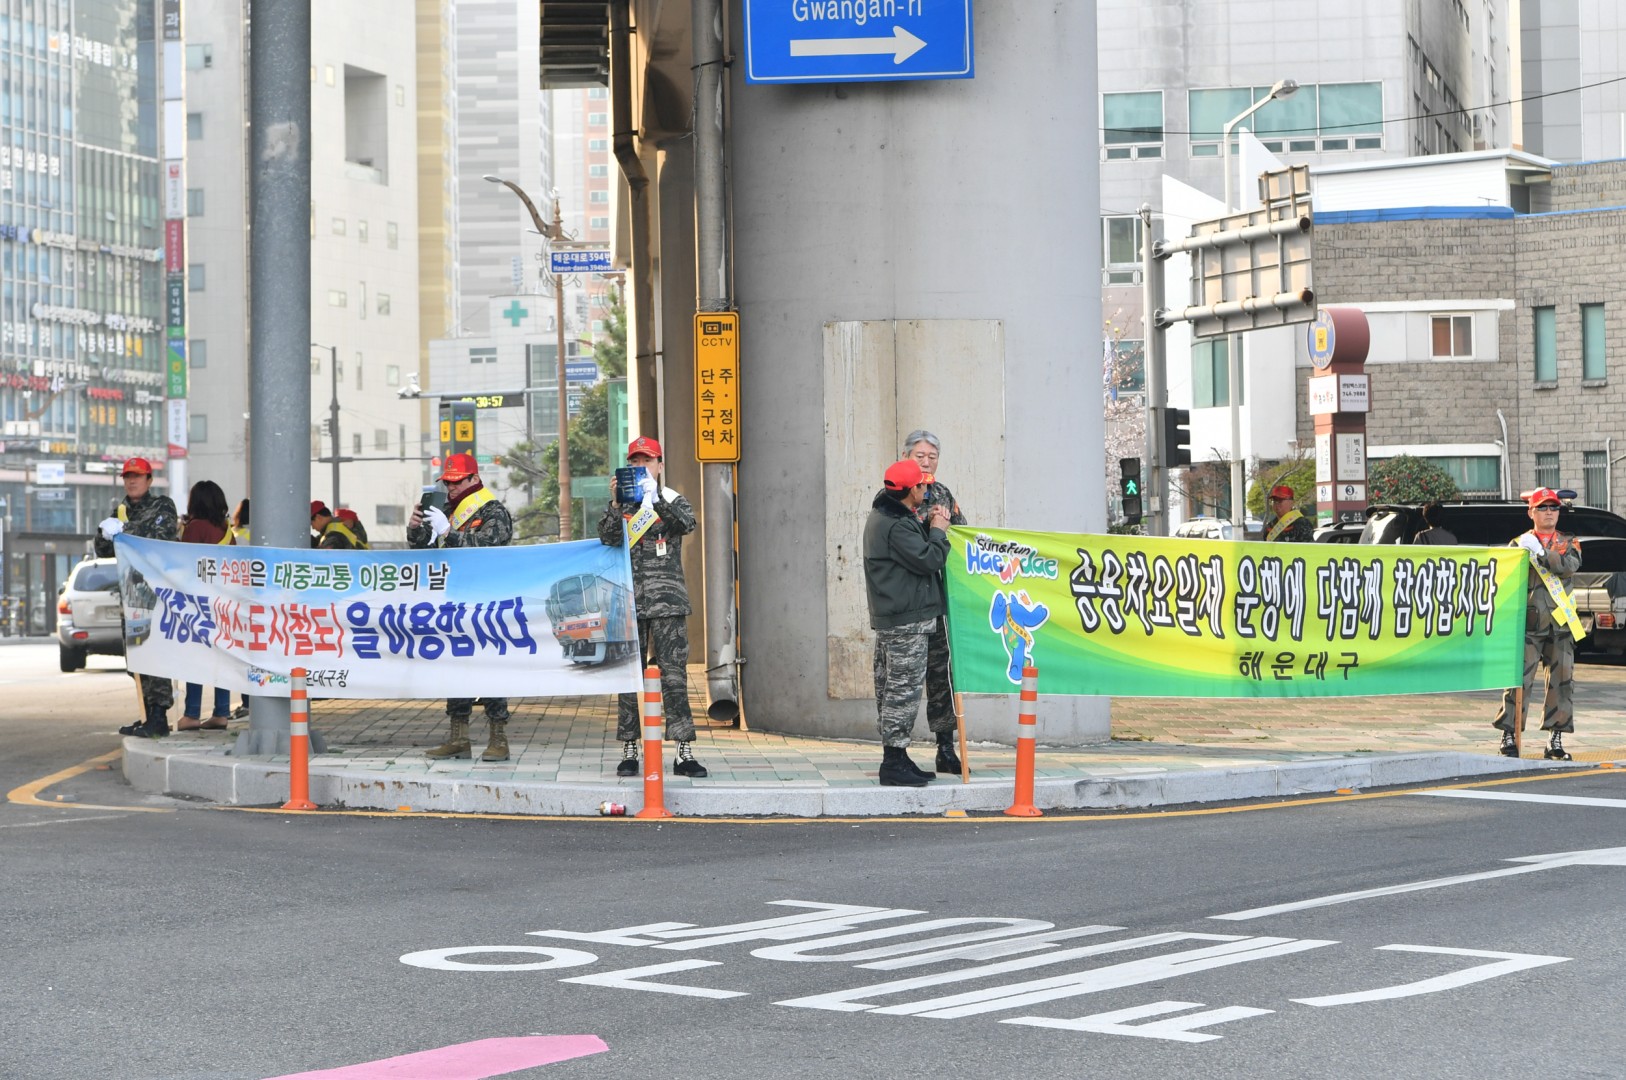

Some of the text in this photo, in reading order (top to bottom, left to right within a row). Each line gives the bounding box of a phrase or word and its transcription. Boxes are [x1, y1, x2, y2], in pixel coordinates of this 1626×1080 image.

[792, 0, 922, 25] Gwangan-ri
[701, 338, 732, 346] CCTV
[701, 368, 716, 445] 단속구역
[197, 559, 448, 591] 매주 수요일은 대중교통 이용의 날
[1070, 548, 1225, 638] 승용차요일제
[1235, 555, 1305, 641] 운행에
[1317, 557, 1383, 641] 다함께
[1393, 557, 1498, 638] 참여합시다
[306, 669, 349, 687] 운대구청
